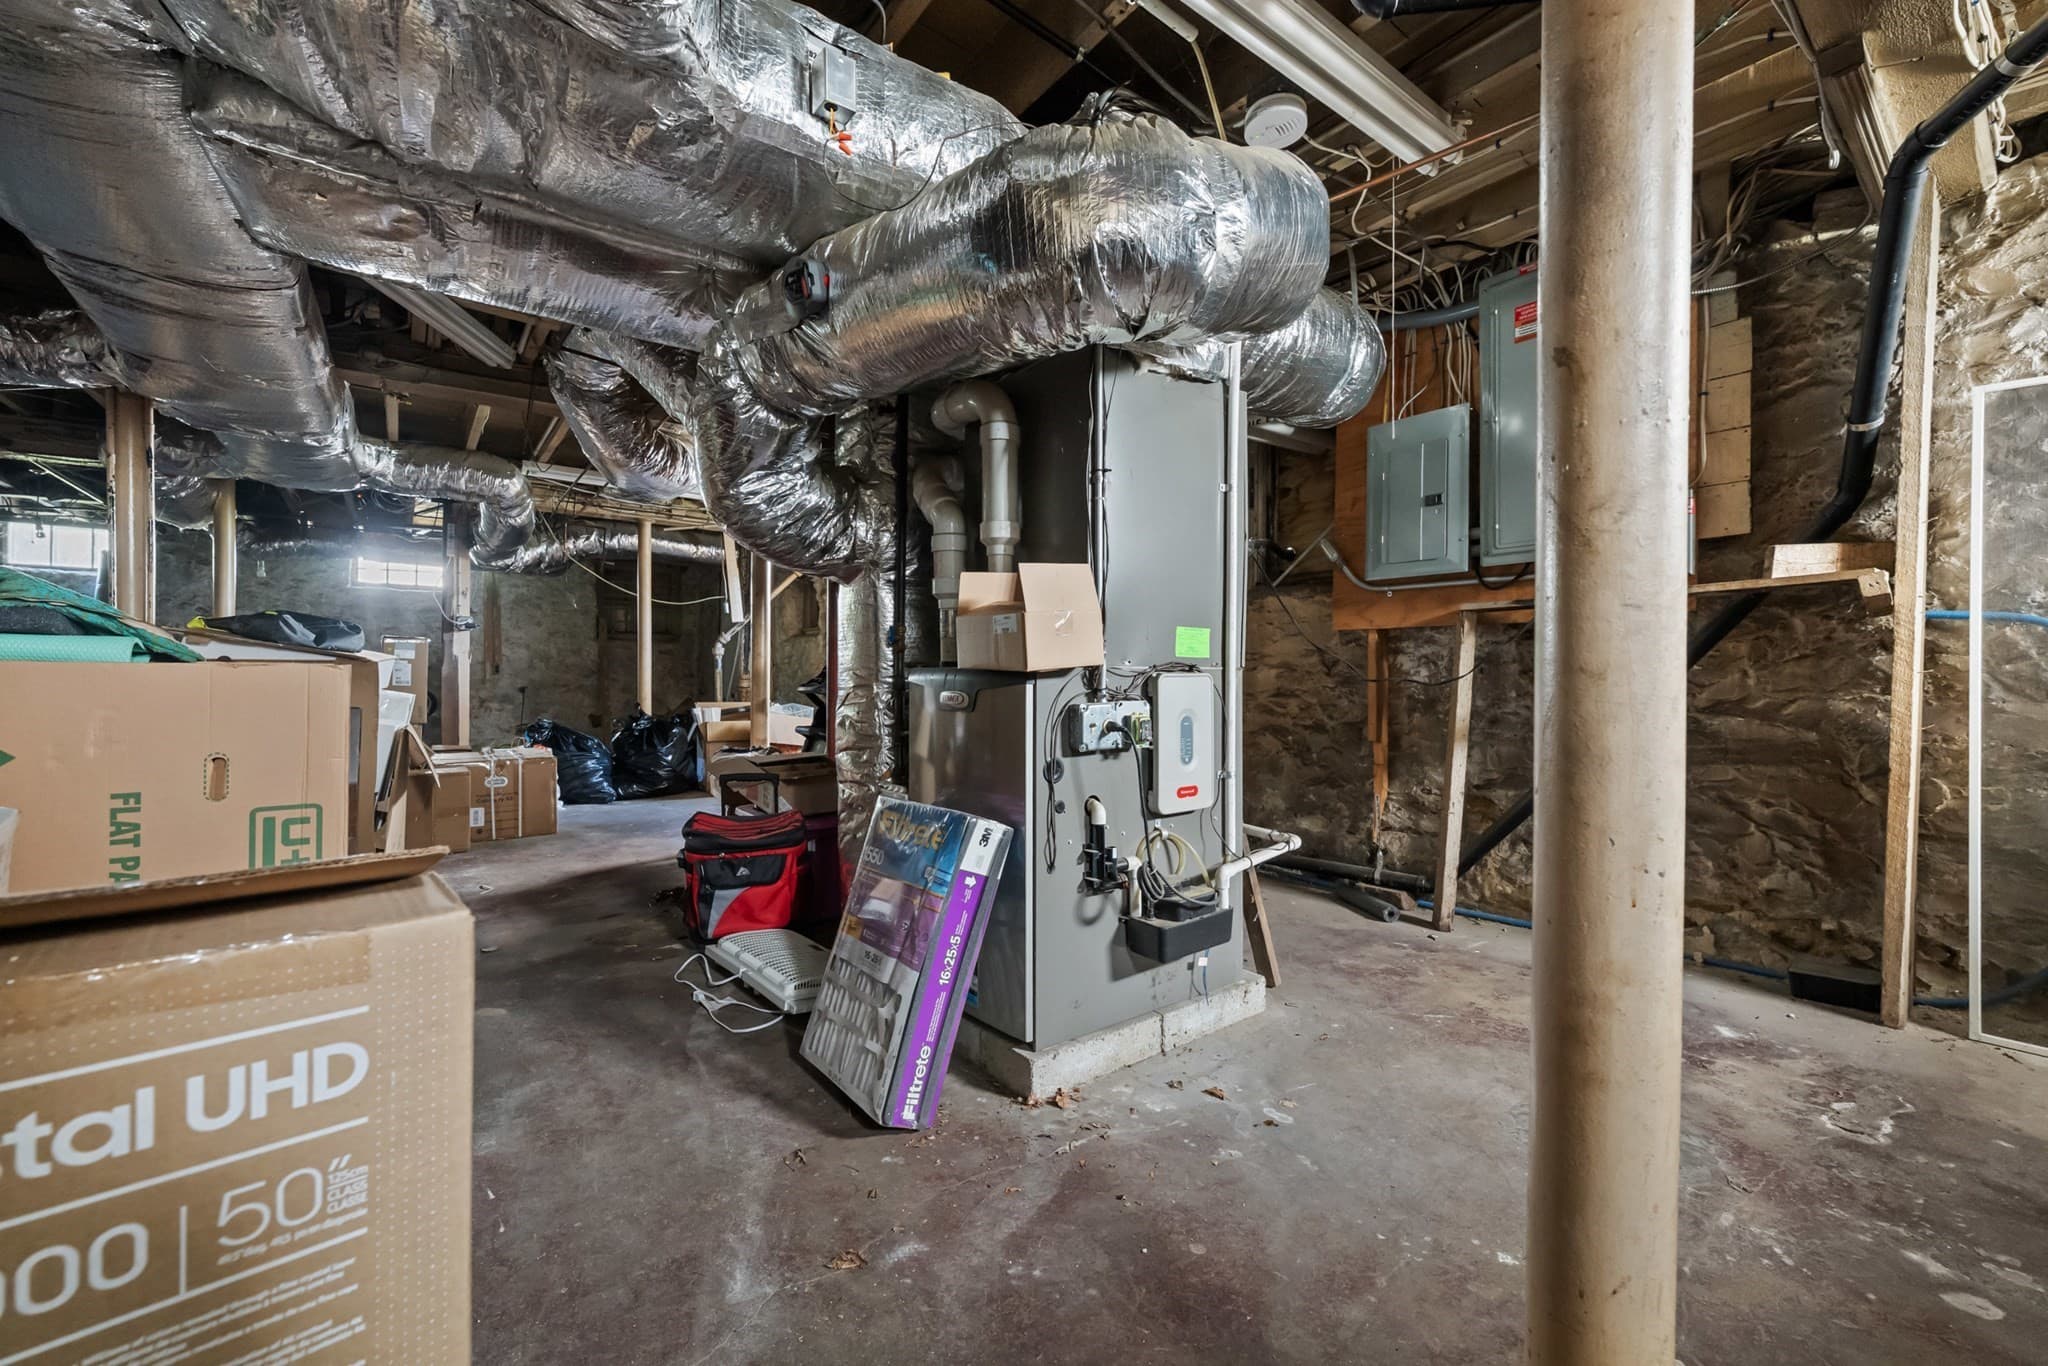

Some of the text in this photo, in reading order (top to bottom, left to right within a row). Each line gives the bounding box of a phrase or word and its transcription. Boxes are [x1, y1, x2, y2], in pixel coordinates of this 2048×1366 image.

[109, 792, 141, 848] FLAT
[979, 827, 994, 848] 3M
[939, 935, 961, 987] 16x25x5
[0, 1041, 370, 1180] tal UHD
[903, 1045, 933, 1121] Filtrete
[0, 1222, 149, 1318] 00
